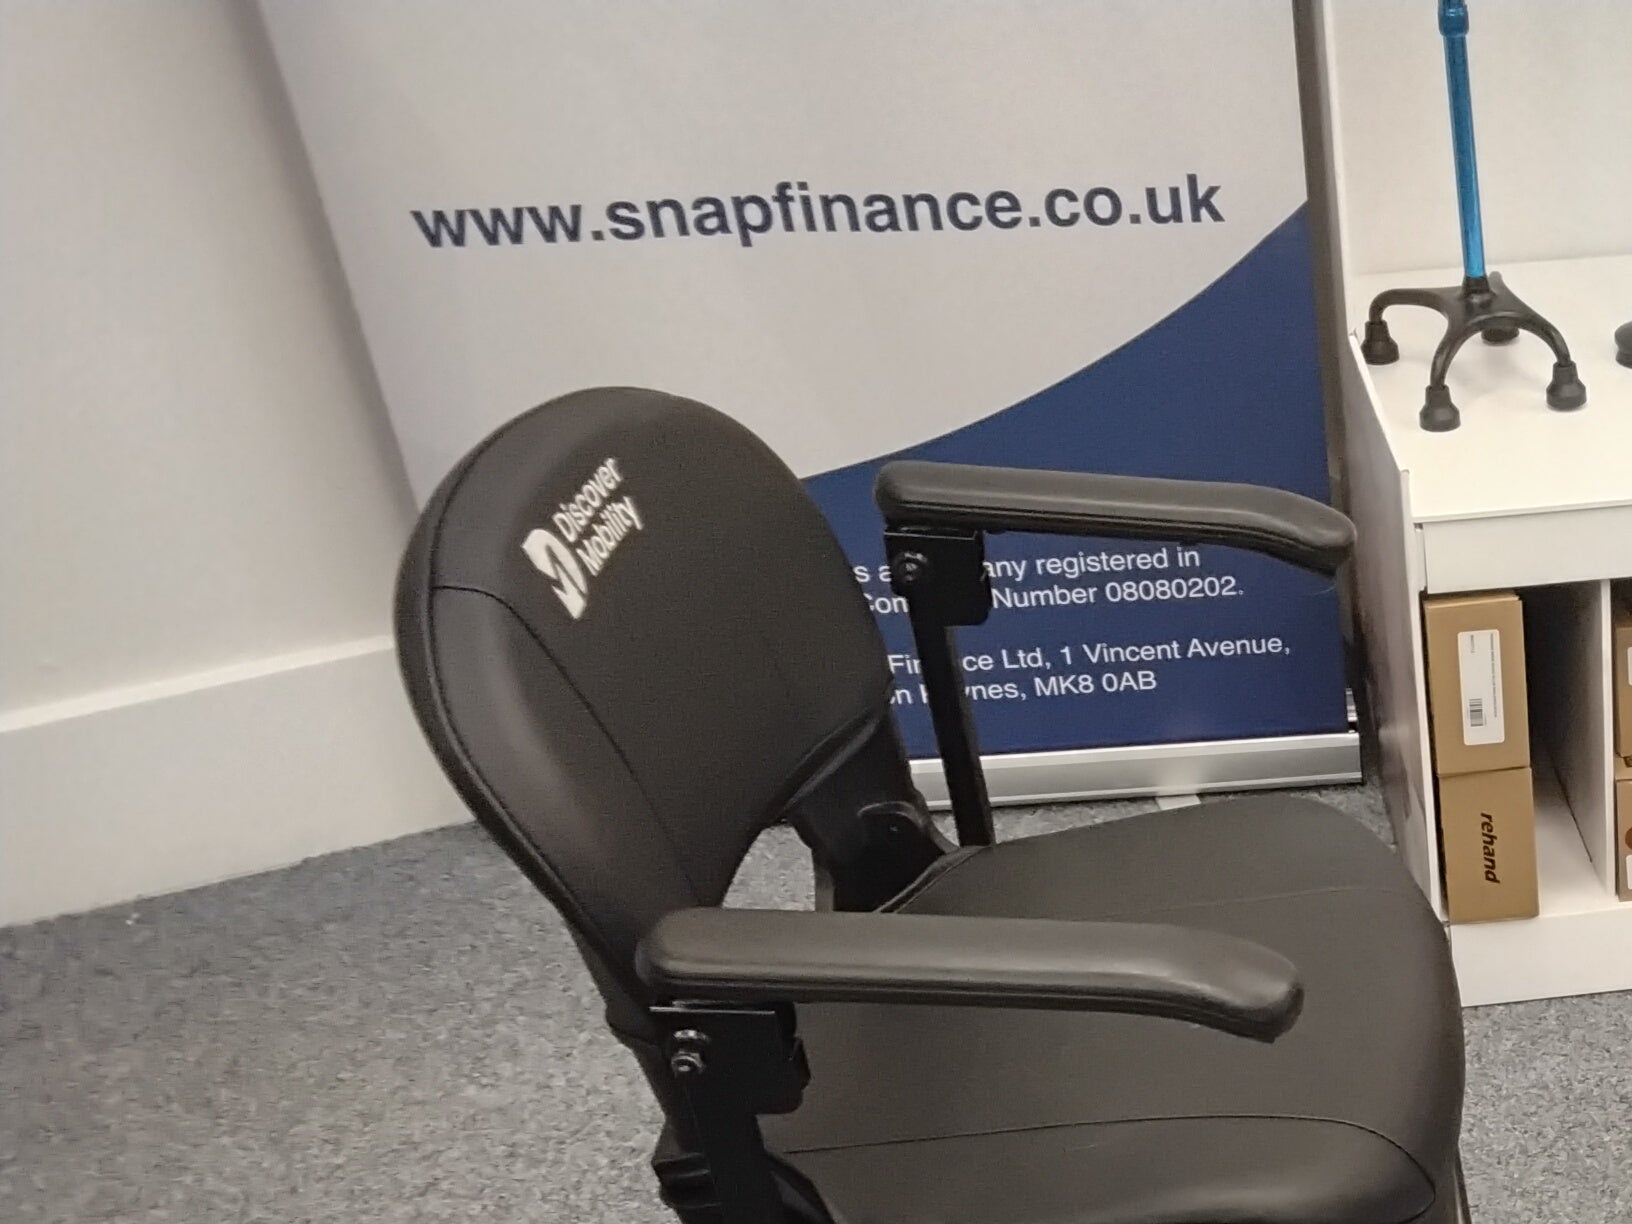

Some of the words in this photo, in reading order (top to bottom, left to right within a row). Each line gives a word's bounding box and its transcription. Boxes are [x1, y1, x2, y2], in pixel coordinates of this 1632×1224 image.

[410, 173, 1226, 248] www.snapfinance.co.uk
[552, 458, 623, 543] Discover
[576, 496, 644, 577] Mobility
[1037, 548, 1170, 576] registered
[1176, 546, 1201, 568] in
[991, 583, 1098, 609] Number
[1104, 575, 1245, 602] 08080202.
[1001, 647, 1051, 670] Ltd,
[1060, 646, 1072, 665] 1
[1082, 640, 1181, 665] Vincent
[1187, 634, 1290, 658] Avenue,
[1034, 673, 1094, 697] MK8
[1102, 669, 1157, 692] 0AB
[1480, 812, 1501, 884] rehand
